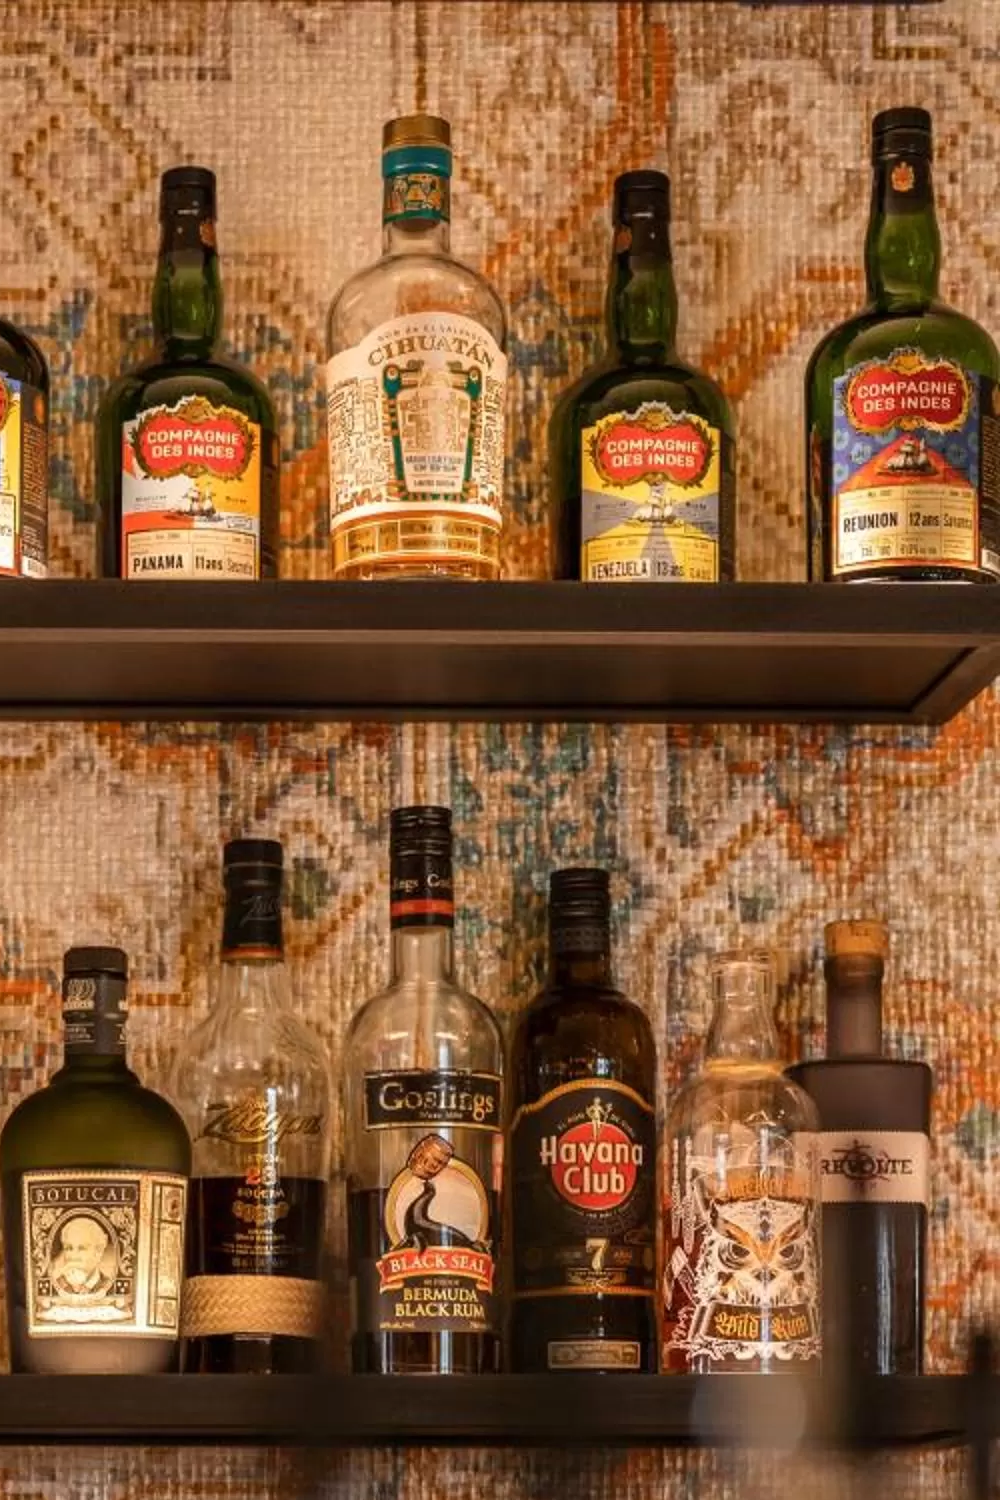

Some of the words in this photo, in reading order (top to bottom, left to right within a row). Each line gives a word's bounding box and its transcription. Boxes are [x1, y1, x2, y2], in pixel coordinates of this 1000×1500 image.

[368, 335, 495, 370] CIHUATÁN
[857, 381, 957, 399] COMPAGNIE
[863, 399, 896, 413] DES
[901, 397, 951, 410] INDES
[147, 429, 241, 446] COMPAGNIE
[606, 439, 700, 454] COMPAGNIE
[152, 445, 183, 459] DES
[188, 445, 235, 460] INDES
[612, 454, 643, 468] DES
[648, 453, 695, 468] INDES
[843, 511, 899, 533] REUNION
[132, 554, 184, 573] PANAMA
[591, 559, 648, 580] VENEZUELA
[379, 1081, 495, 1122] Goslings
[540, 1135, 644, 1166] Havana
[563, 1166, 626, 1194] Club
[35, 1187, 131, 1202] BOTUCAL
[390, 1252, 448, 1274] BLACK
[450, 1254, 487, 1274] SEAL
[585, 1237, 610, 1272] 7
[403, 1287, 480, 1303] BERMUDA
[394, 1302, 450, 1318] BLACK
[452, 1302, 486, 1321] RUM
[714, 1310, 761, 1339] Wild
[770, 1311, 809, 1340] Rum
